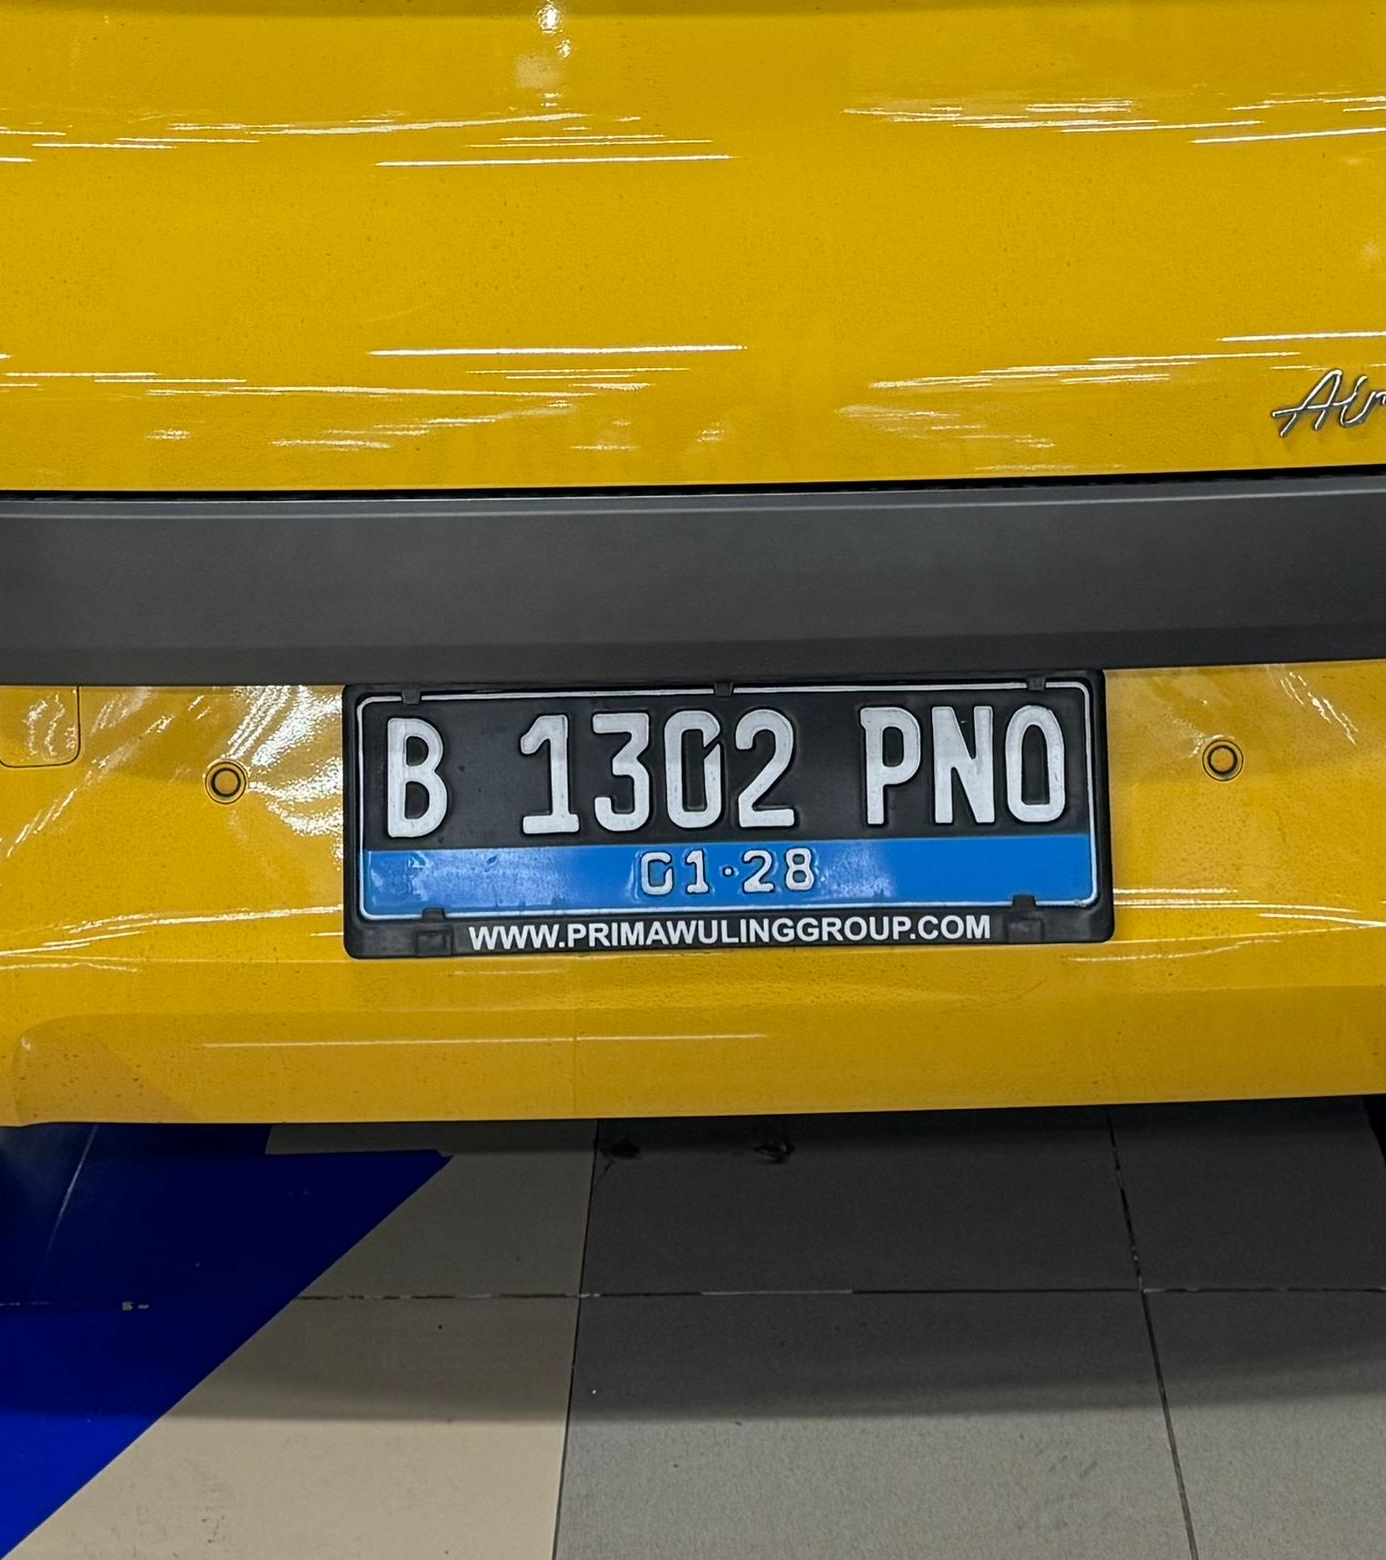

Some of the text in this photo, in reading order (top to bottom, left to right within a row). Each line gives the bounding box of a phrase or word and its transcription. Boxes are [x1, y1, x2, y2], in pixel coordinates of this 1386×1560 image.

[386, 704, 1066, 839] B 1302 PNO
[469, 914, 992, 952] WWW.PRIMAWULINGGROUP.COM
